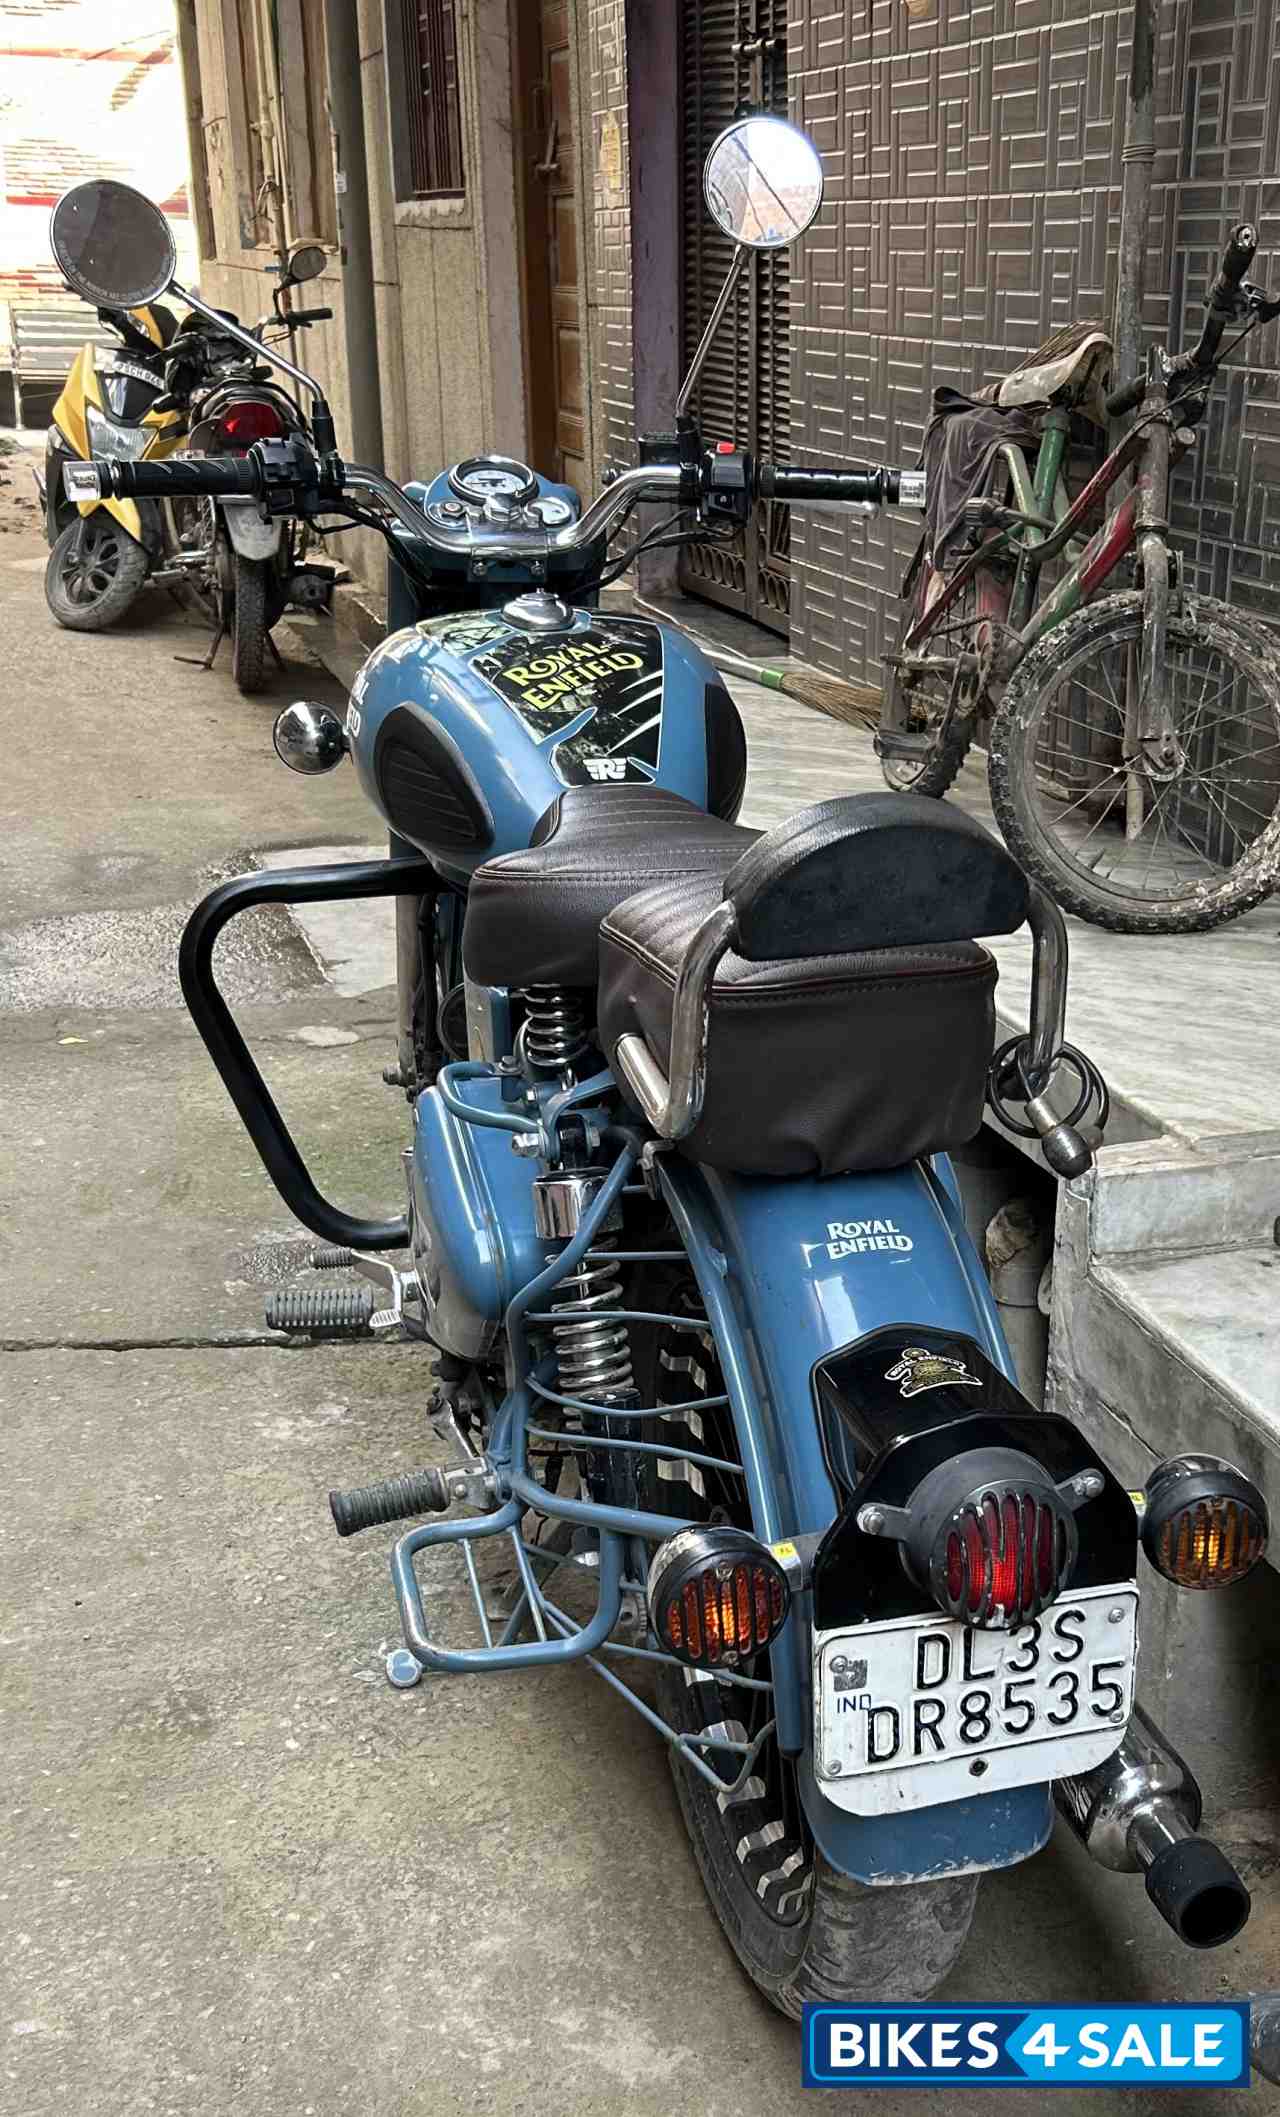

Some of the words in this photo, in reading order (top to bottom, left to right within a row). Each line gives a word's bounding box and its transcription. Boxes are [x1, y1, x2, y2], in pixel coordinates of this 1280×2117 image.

[503, 642, 609, 686] ROYAL
[520, 652, 644, 710] ENFIELD
[826, 1235, 913, 1260] ENFIELD
[827, 1219, 900, 1240] ROYAL
[916, 1608, 1086, 1690] DL3S
[837, 1693, 872, 1714] IND
[866, 1659, 1126, 1765] DR8535
